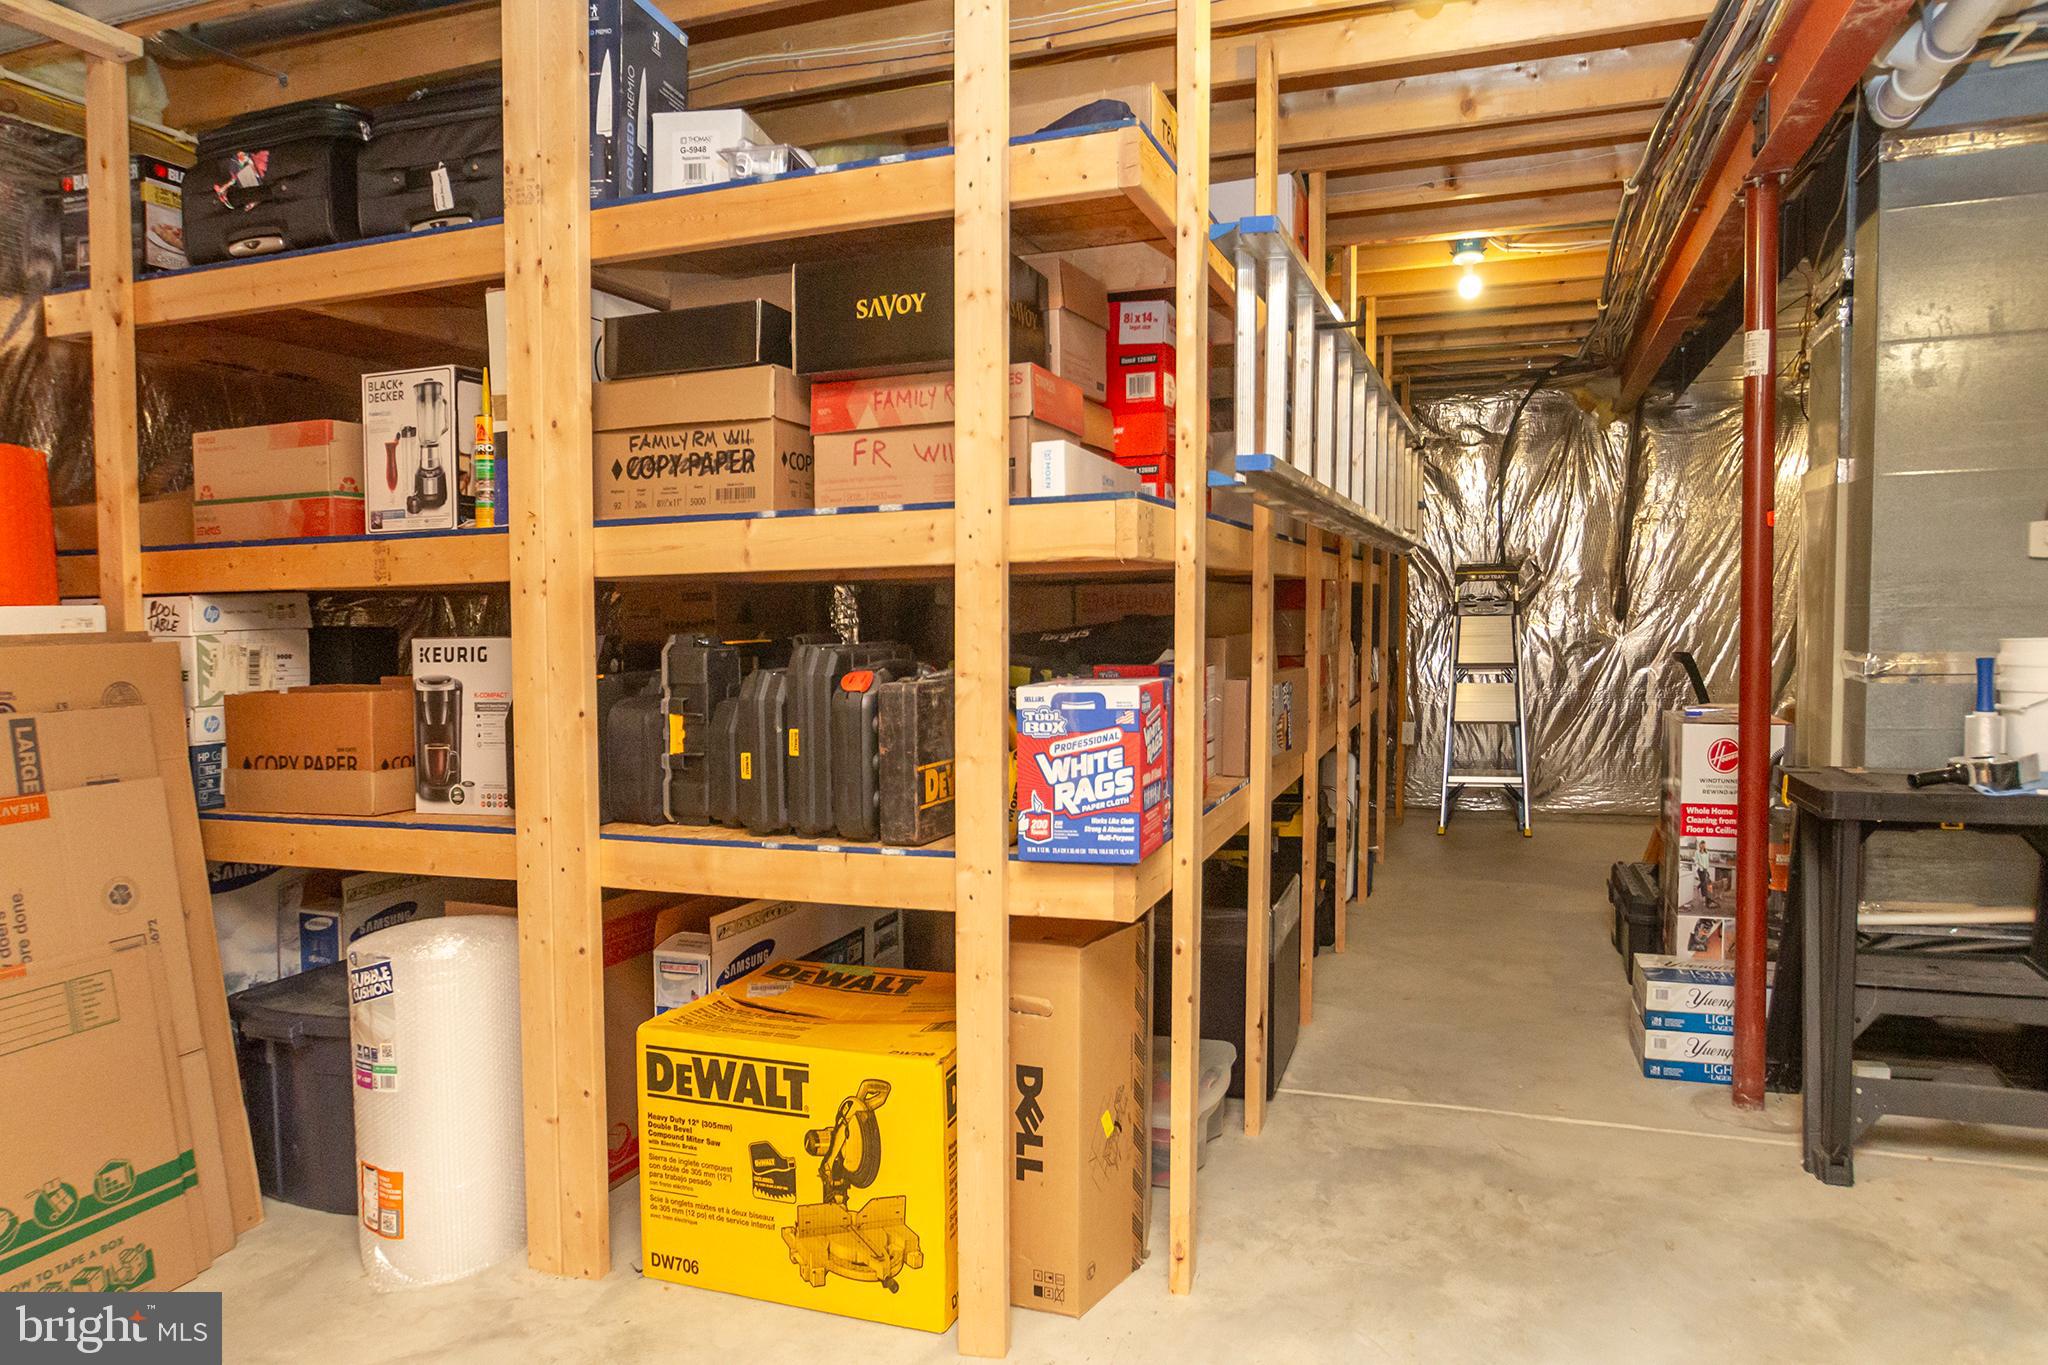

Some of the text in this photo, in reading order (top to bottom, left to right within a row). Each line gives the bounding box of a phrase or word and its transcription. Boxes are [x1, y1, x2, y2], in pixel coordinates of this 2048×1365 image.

[626, 64, 636, 190] FORGED PREMIO
[856, 292, 926, 321] SAVOY
[1142, 312, 1153, 323] 14
[368, 379, 404, 392] BLACK+
[368, 390, 404, 404] DECKER
[873, 385, 937, 412] FAMILY
[629, 431, 689, 452] FAMILY
[692, 430, 718, 448] RM
[626, 448, 756, 480] COPY PAPER
[419, 645, 488, 663] KEURIG
[1023, 710, 1063, 721] TOOL
[1024, 720, 1066, 735] BOX
[1054, 733, 1120, 754] PROFESSIONAL
[14, 727, 40, 794] LARGE
[198, 752, 209, 762] HP
[1034, 747, 1124, 785] WHITE
[1054, 766, 1135, 816] RAGS
[1082, 797, 1130, 812] PAPER CLOTH
[1686, 806, 1734, 815] Whole Home
[1686, 816, 1738, 827] Cleaning from
[1686, 825, 1705, 833] Floor
[1705, 826, 1714, 834] to
[1098, 834, 1135, 842] Multi-Purpose
[12, 893, 28, 935] done
[724, 948, 771, 980] SAMSUNG
[353, 980, 392, 1001] CUSHION
[648, 1112, 668, 1123] Heavy
[670, 1115, 685, 1125] Duty
[702, 1120, 733, 1132] (305mm)
[648, 1121, 692, 1133] Double Bevel
[1015, 1063, 1045, 1181] DELL
[648, 1130, 720, 1147] Compound Miter Saw
[661, 1140, 680, 1148] Electric
[649, 1153, 667, 1162] Sierra
[669, 1155, 677, 1163] de
[678, 1157, 699, 1168] inglete
[649, 1172, 712, 1186] para trabajo pesado
[662, 1164, 680, 1173] doble
[691, 1168, 702, 1177] 305
[717, 1172, 732, 1182] (12")
[650, 1194, 664, 1202] Scie
[670, 1197, 694, 1208] onglets
[695, 1201, 716, 1212] mixtes
[732, 1207, 747, 1216] deux
[748, 1210, 774, 1221] biseaux
[660, 1205, 671, 1213] 305
[686, 1208, 695, 1217] (12
[697, 1210, 707, 1219] po)
[716, 1213, 724, 1221] de
[726, 1216, 749, 1227] service
[751, 1219, 775, 1230] intensif
[36, 1269, 53, 1282] TO
[55, 1254, 86, 1274] TAPE
[89, 1250, 97, 1259] A
[100, 1236, 124, 1254] BOX
[651, 1252, 699, 1275] DW706
